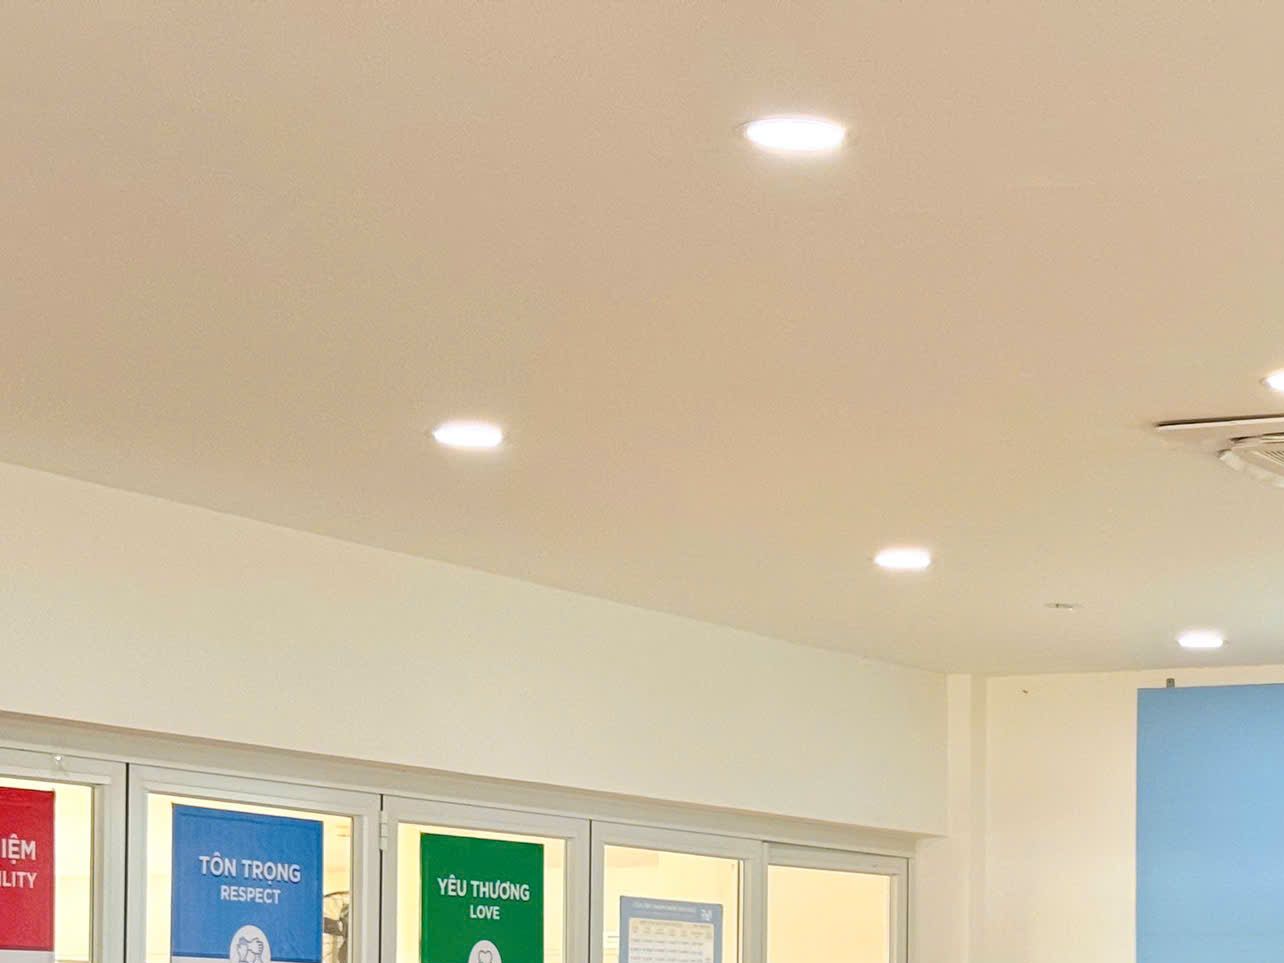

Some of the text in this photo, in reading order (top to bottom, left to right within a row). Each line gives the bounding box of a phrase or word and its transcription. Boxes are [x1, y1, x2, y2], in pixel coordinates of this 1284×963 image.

[199, 851, 301, 885] TÔN TRỌNG
[220, 885, 281, 905] RESPECT
[437, 874, 530, 901] YÊU THƯƠNG
[469, 904, 501, 920] LOVE
